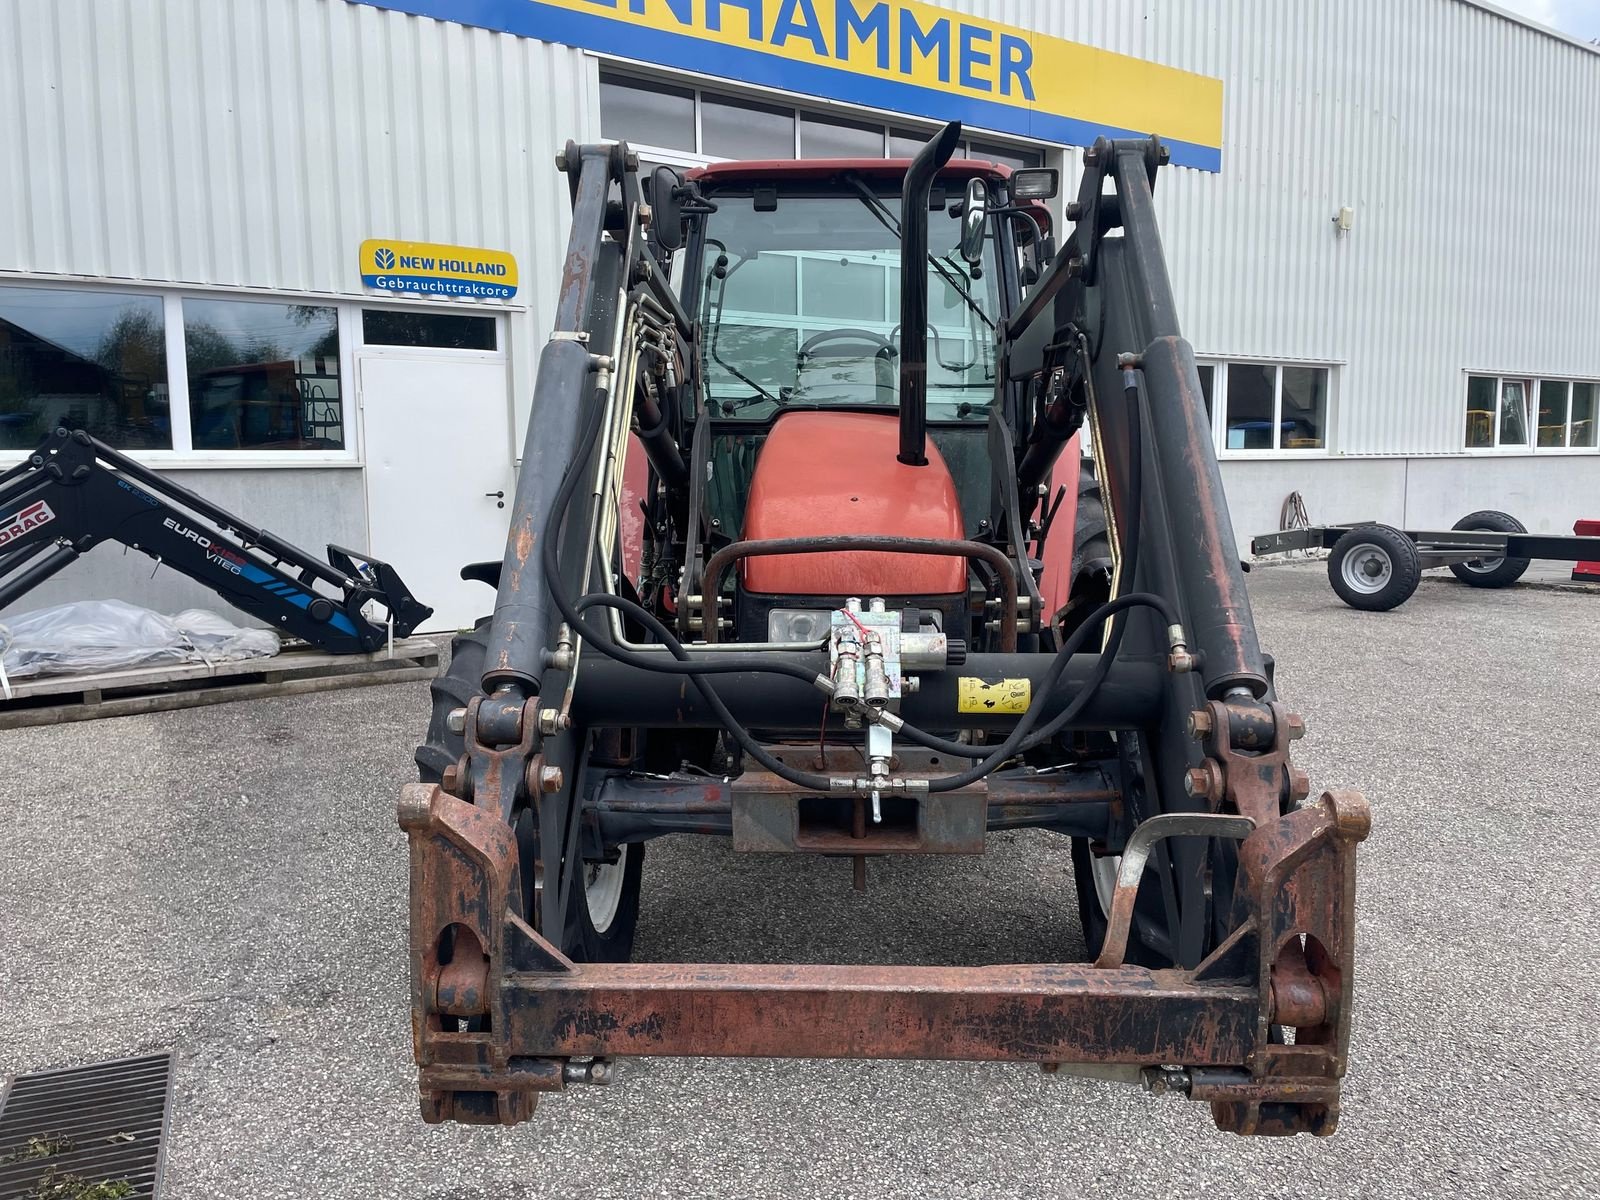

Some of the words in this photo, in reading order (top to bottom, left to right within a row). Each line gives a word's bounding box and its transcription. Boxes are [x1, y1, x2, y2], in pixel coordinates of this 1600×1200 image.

[582, 0, 1036, 102] HAMMER
[400, 255, 435, 271] NEW
[439, 259, 507, 276] HOLLAND
[376, 276, 509, 297] Gebrauchttraktore
[206, 549, 242, 575] VITEC
